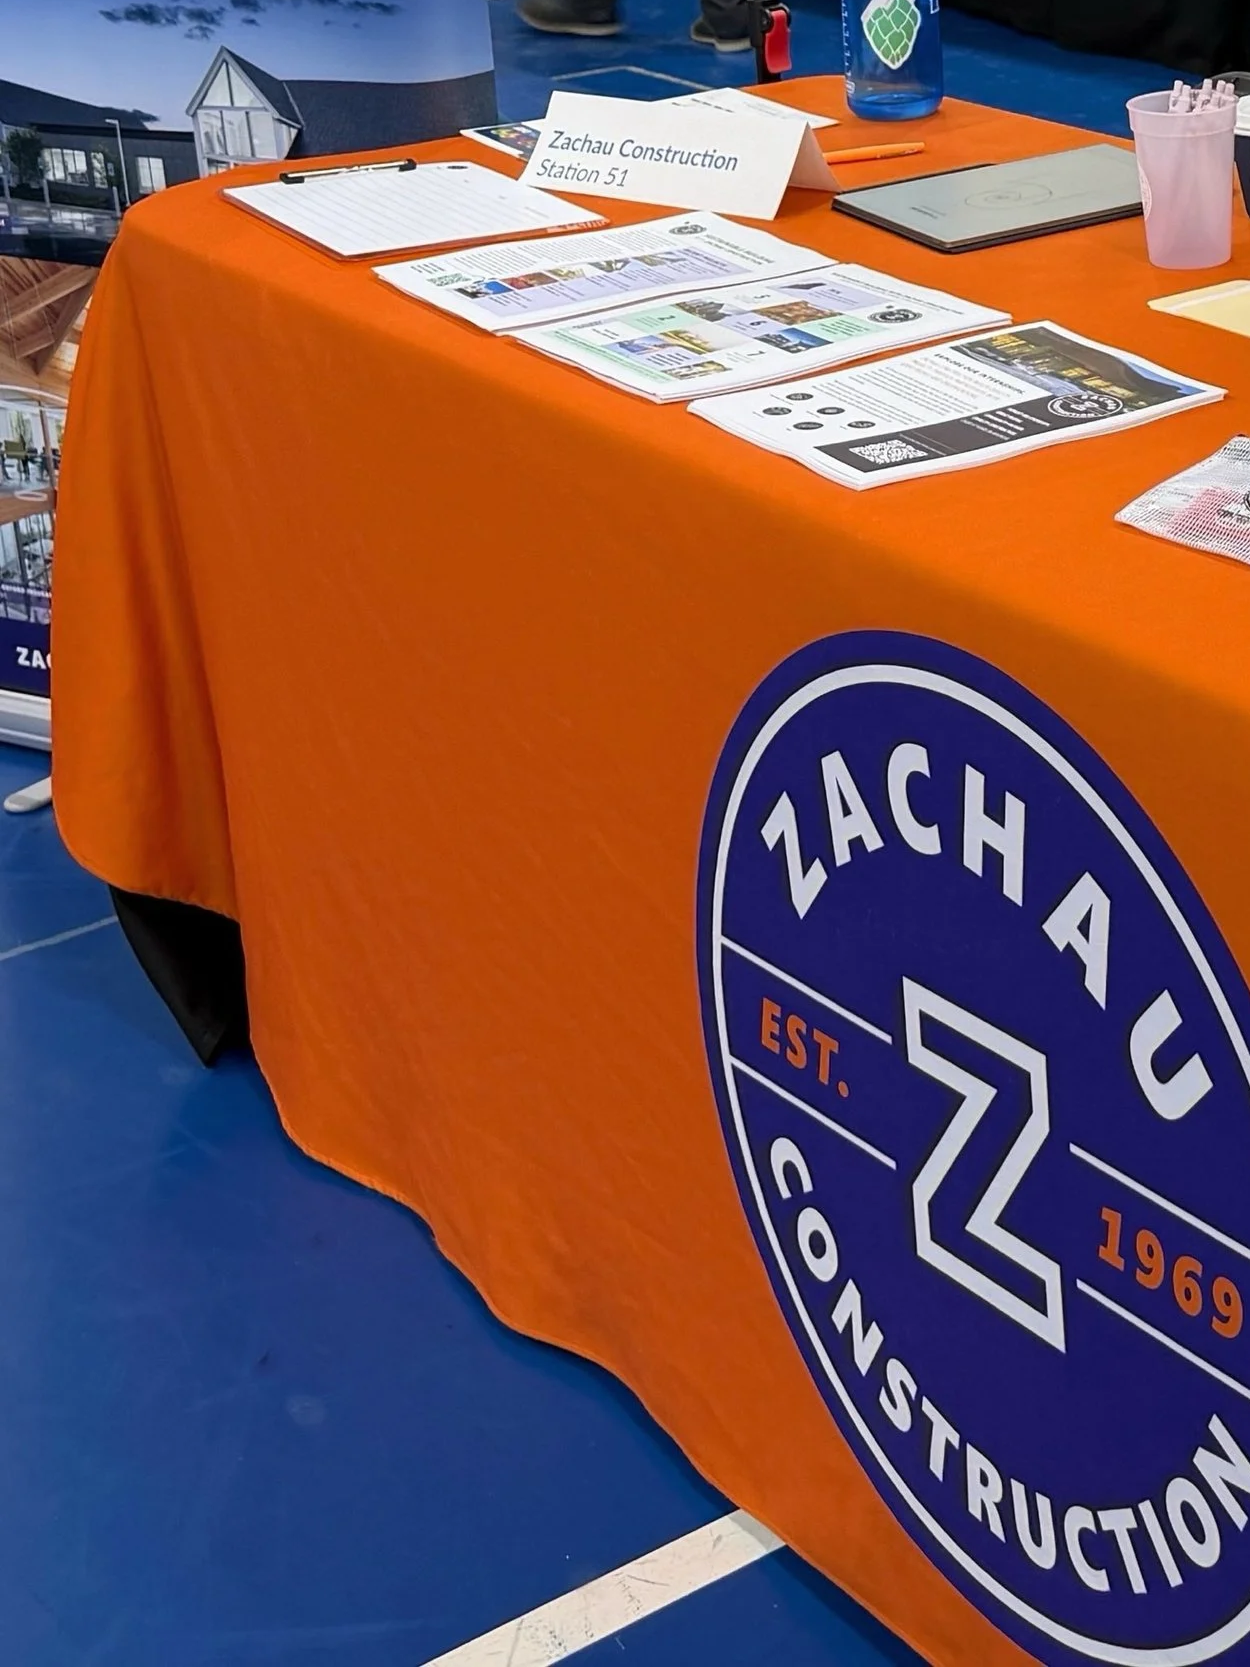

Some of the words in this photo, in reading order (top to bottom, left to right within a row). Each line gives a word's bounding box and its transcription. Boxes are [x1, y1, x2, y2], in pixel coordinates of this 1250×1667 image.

[536, 158, 600, 185] Station
[603, 168, 630, 188] 51
[547, 130, 615, 157] Zachau
[618, 138, 739, 172] Construction
[760, 740, 1214, 1121] ZACHAU
[759, 996, 851, 1099] EST.
[1097, 1206, 1244, 1340] 1969
